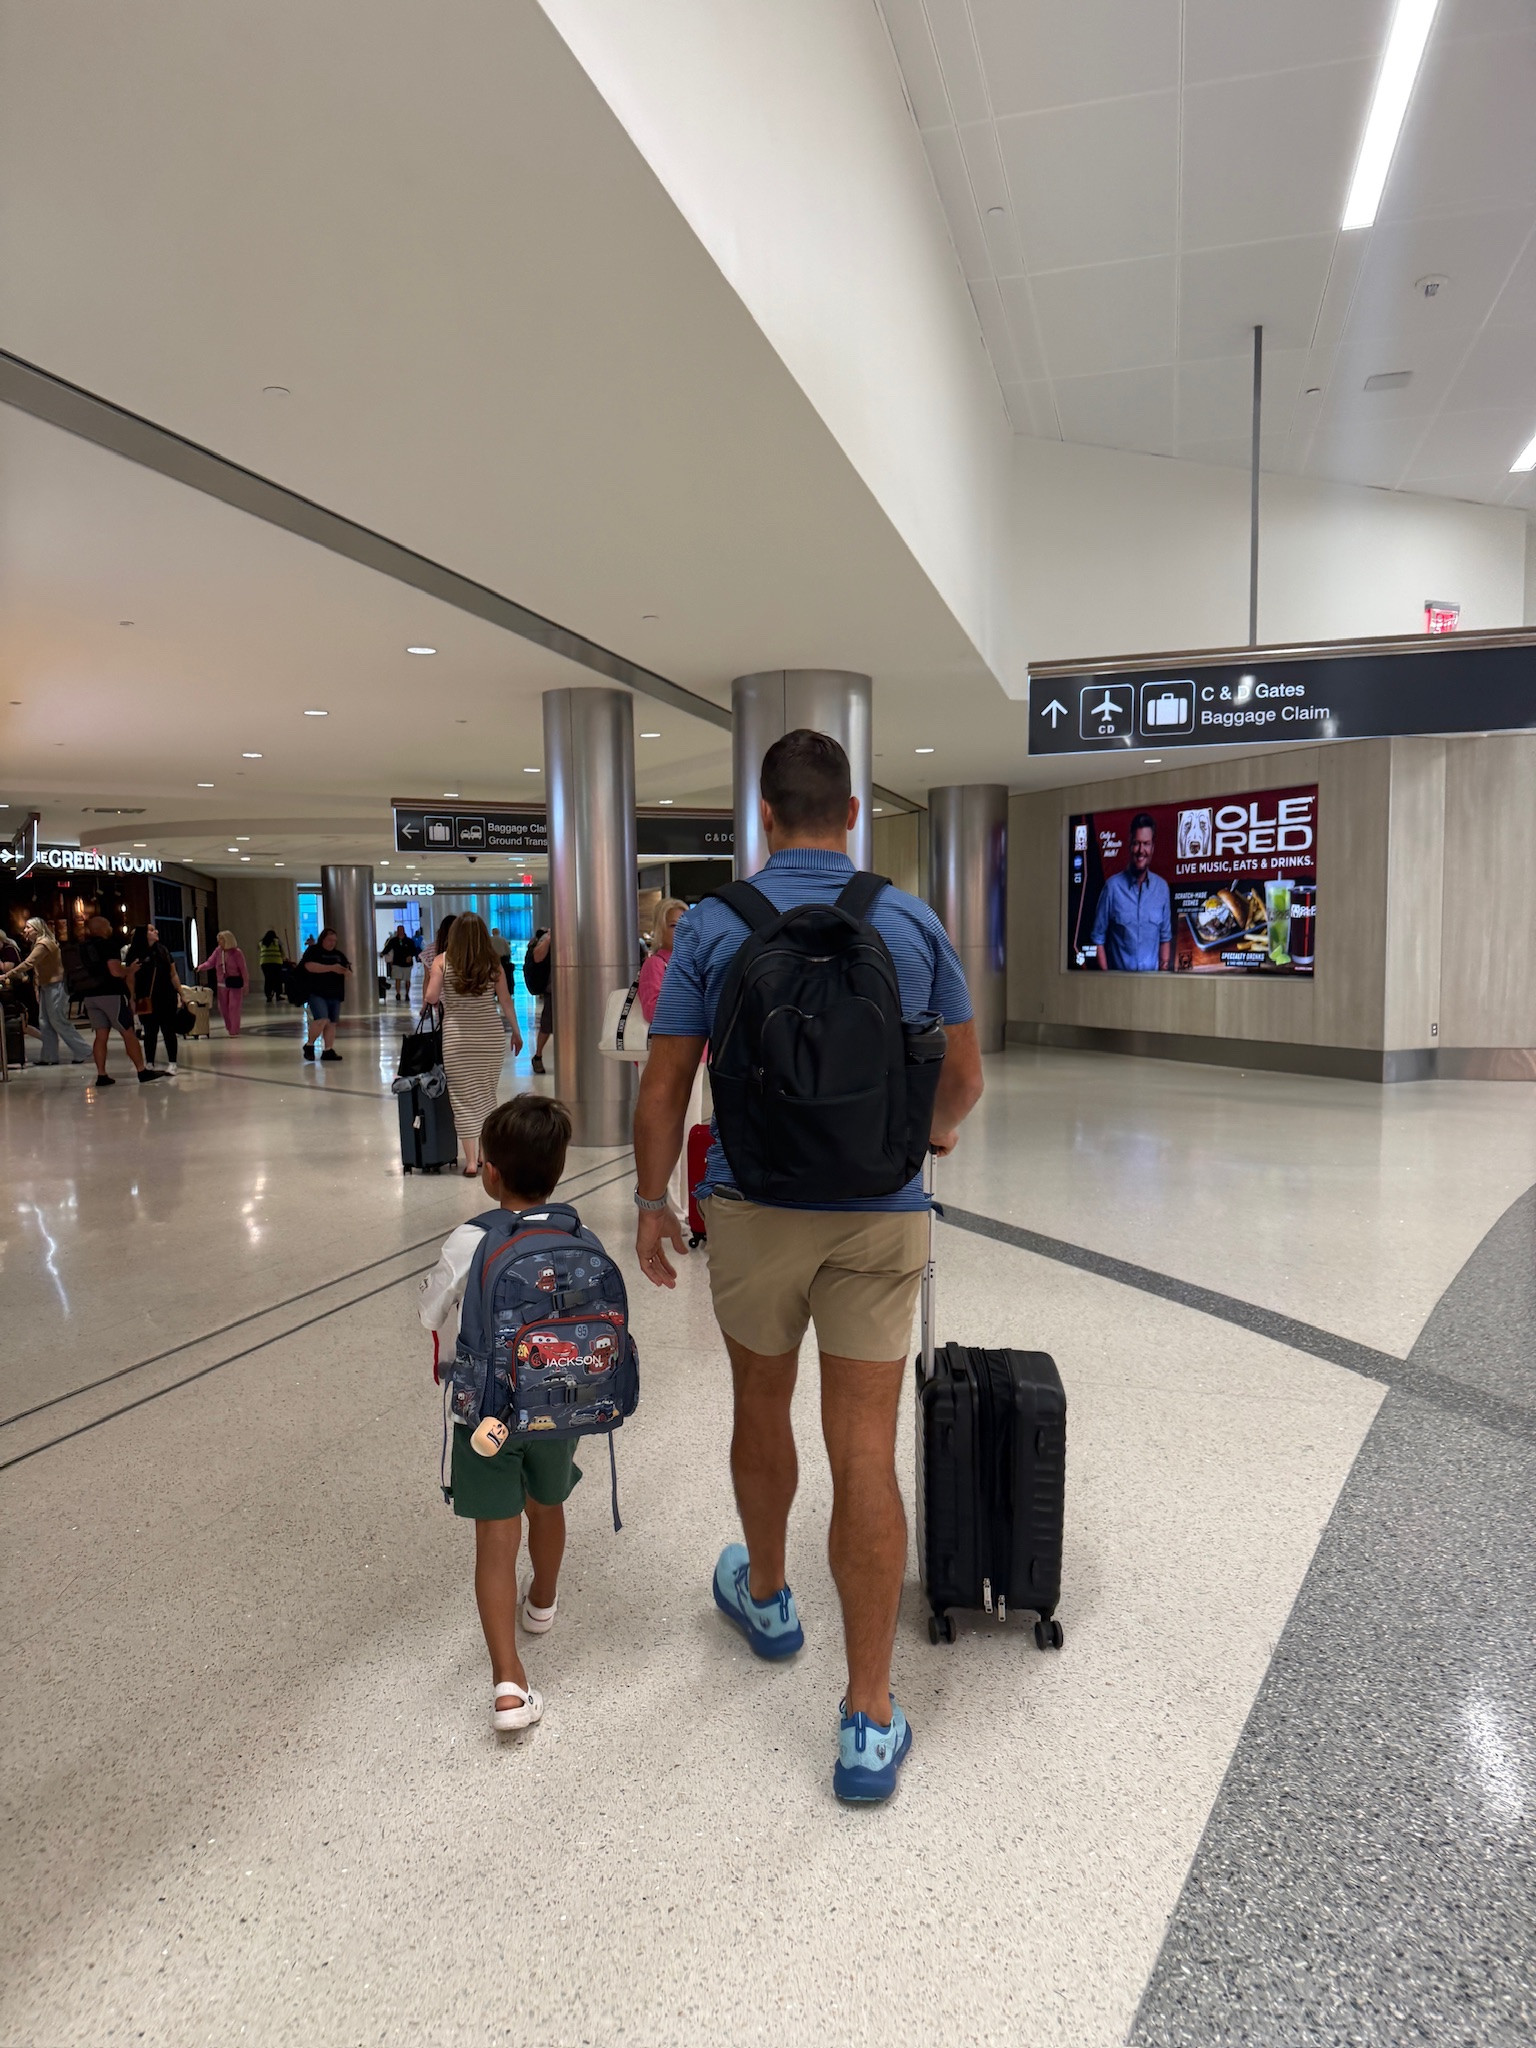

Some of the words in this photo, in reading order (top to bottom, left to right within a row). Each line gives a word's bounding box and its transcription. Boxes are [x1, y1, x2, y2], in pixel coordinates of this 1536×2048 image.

[1201, 686, 1215, 702] C
[1219, 685, 1232, 700] &
[1237, 685, 1251, 700] D
[1255, 682, 1305, 698] Gates
[1201, 710, 1277, 727] Baggage
[1281, 705, 1331, 721] Claim
[1214, 796, 1314, 831] OLE
[487, 822, 528, 834] Baggage
[530, 823, 547, 834] Clai
[488, 835, 523, 846] Ground
[524, 836, 548, 847] Trans
[1214, 824, 1313, 856] RED
[35, 851, 48, 864] HE
[48, 849, 107, 871] GREEN
[111, 856, 157, 873] ROOM
[1176, 863, 1196, 875] LIVE
[1199, 861, 1232, 874] MUSIC,
[1233, 858, 1259, 872] EATS
[1260, 858, 1268, 870] &
[1270, 855, 1315, 869] DRINKS.
[391, 883, 435, 896] GATES
[577, 1326, 587, 1337] 95
[544, 1354, 602, 1368] JACKSON
